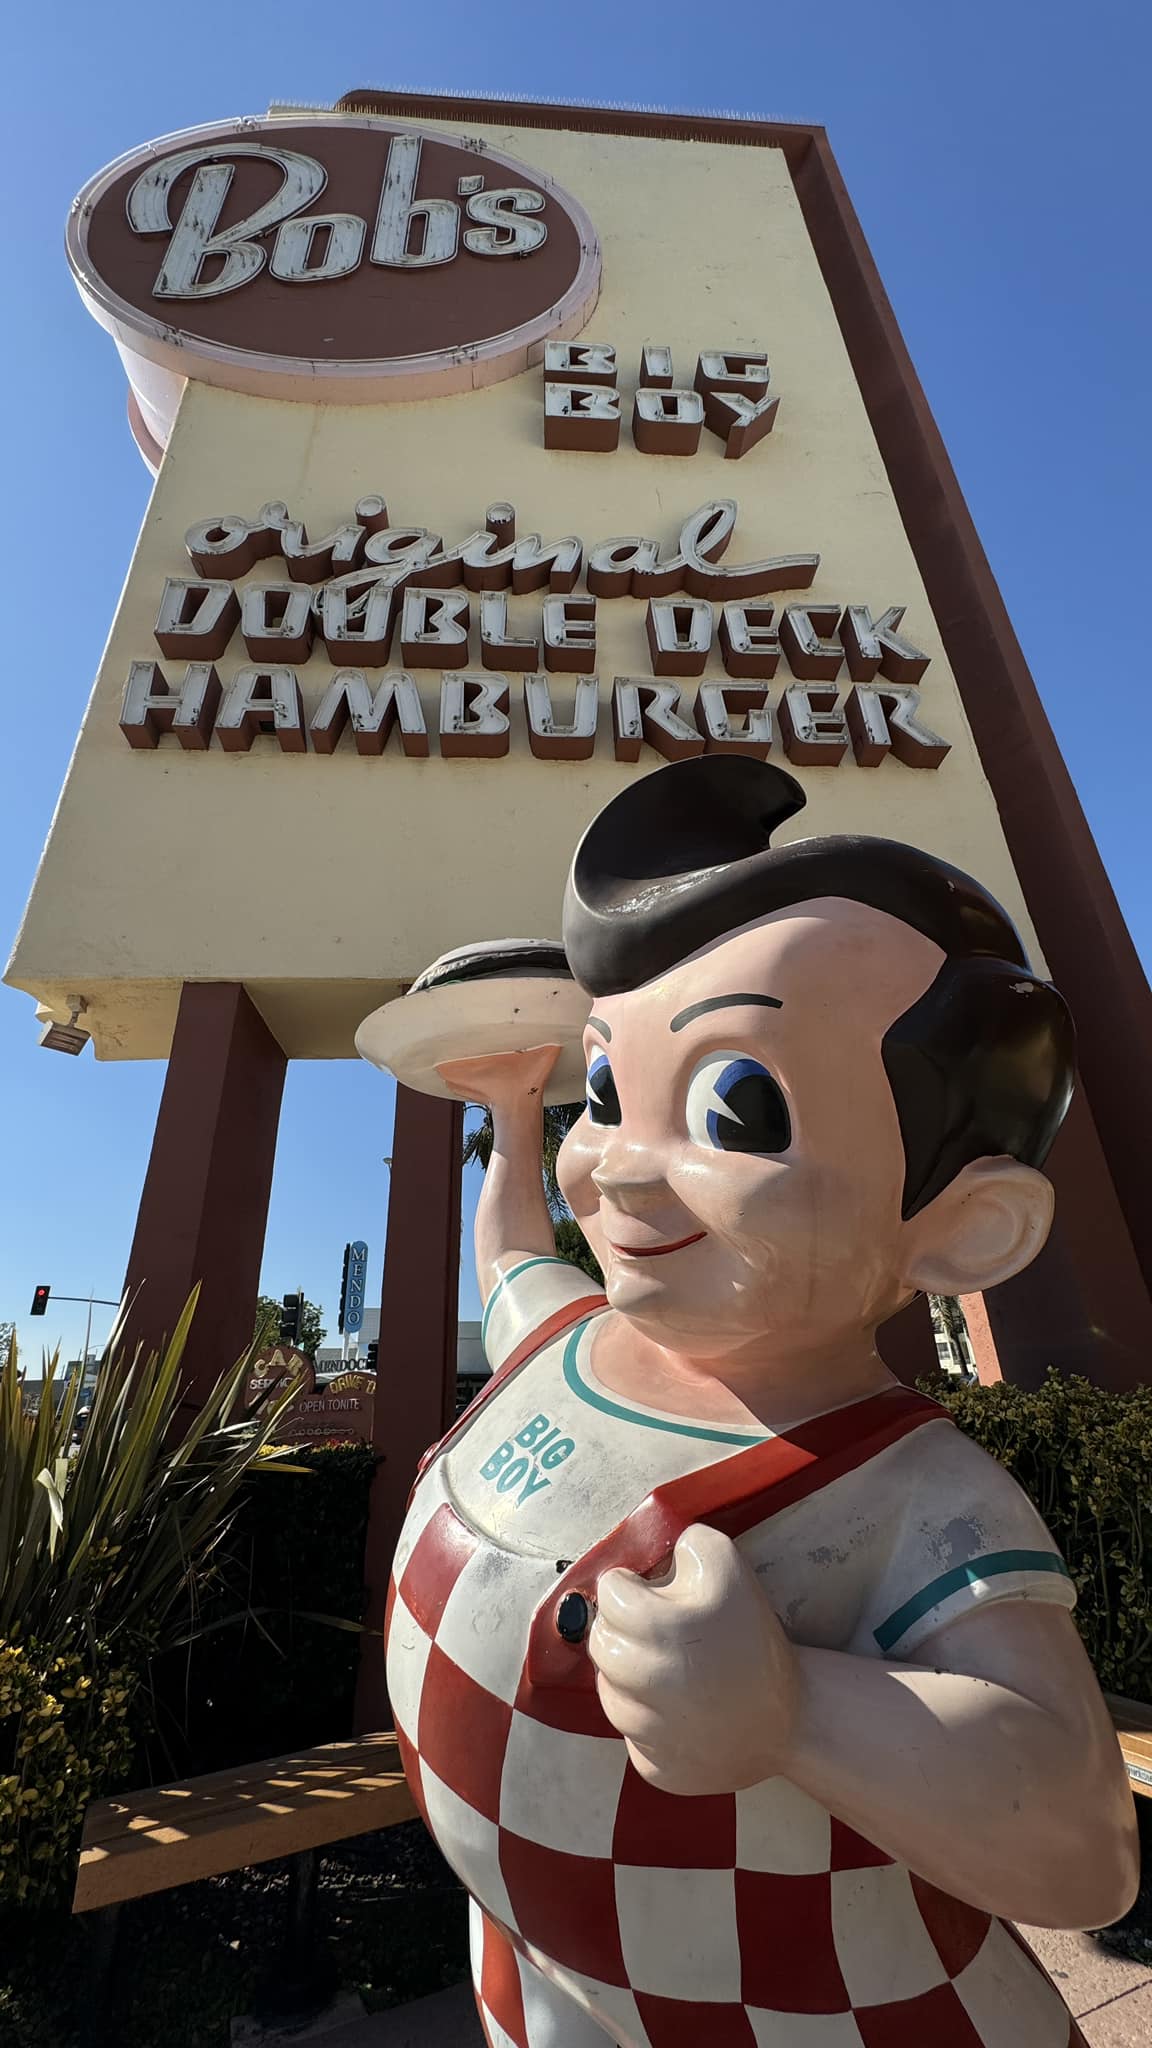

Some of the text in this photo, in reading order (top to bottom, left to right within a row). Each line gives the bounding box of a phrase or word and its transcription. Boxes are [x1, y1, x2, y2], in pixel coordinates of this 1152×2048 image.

[125, 135, 548, 300] Bob's
[544, 341, 771, 386] BIG
[543, 382, 781, 432] BOY
[184, 495, 821, 617] original
[154, 577, 929, 665] DOUBLE DECK
[119, 660, 952, 753] HAMBURGER
[347, 1248, 366, 1325] MENDO
[299, 1400, 325, 1413] OPEN
[328, 1399, 360, 1411] TONITE
[329, 1374, 365, 1394] DRIVE
[479, 1440, 552, 1510] BOY
[514, 1413, 576, 1471] BIG
